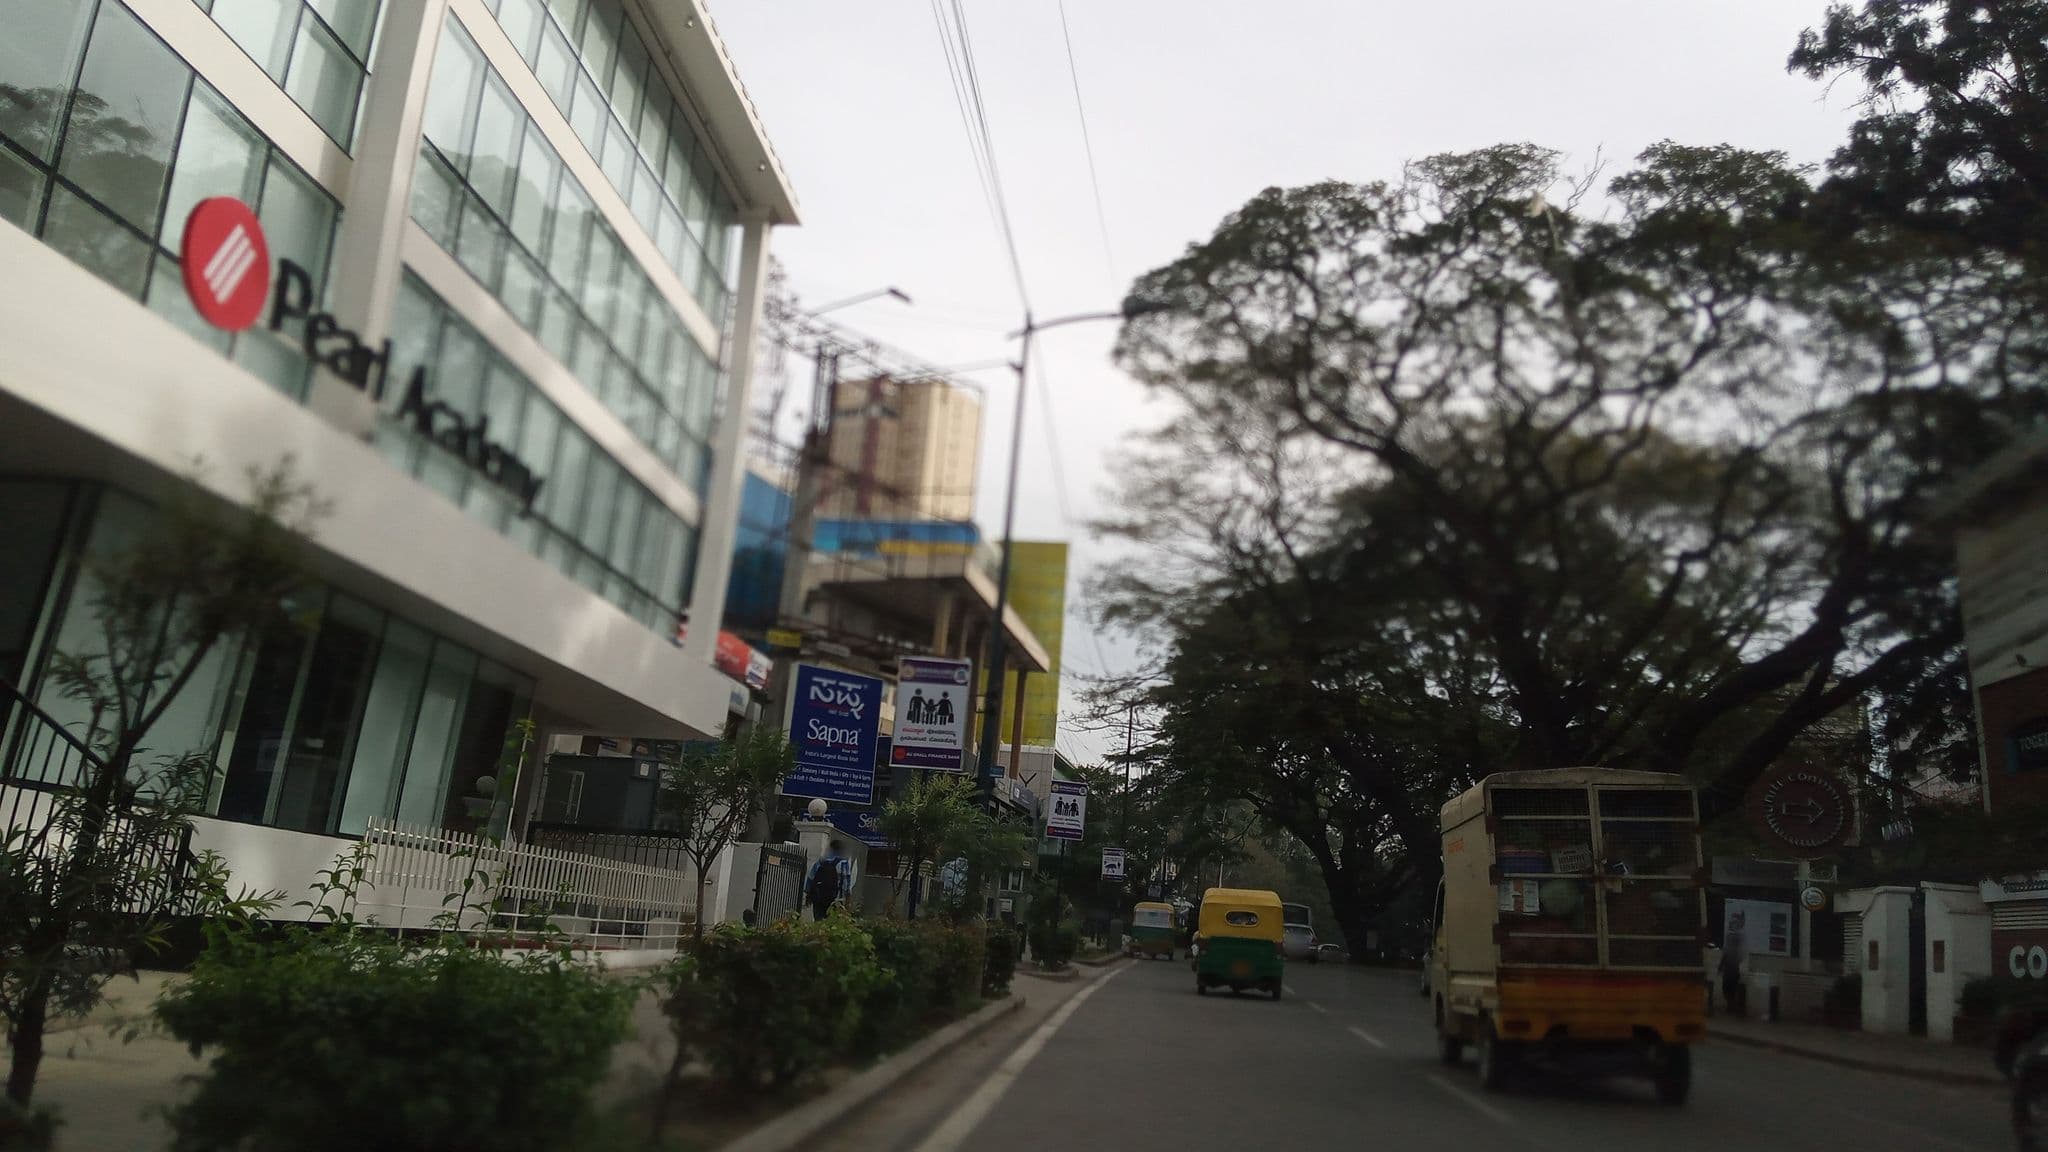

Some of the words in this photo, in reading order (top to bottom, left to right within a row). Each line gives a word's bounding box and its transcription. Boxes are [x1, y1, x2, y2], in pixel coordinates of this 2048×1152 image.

[270, 258, 392, 402] Pearl
[396, 364, 543, 518] Academy
[807, 719, 858, 748] Sapna
